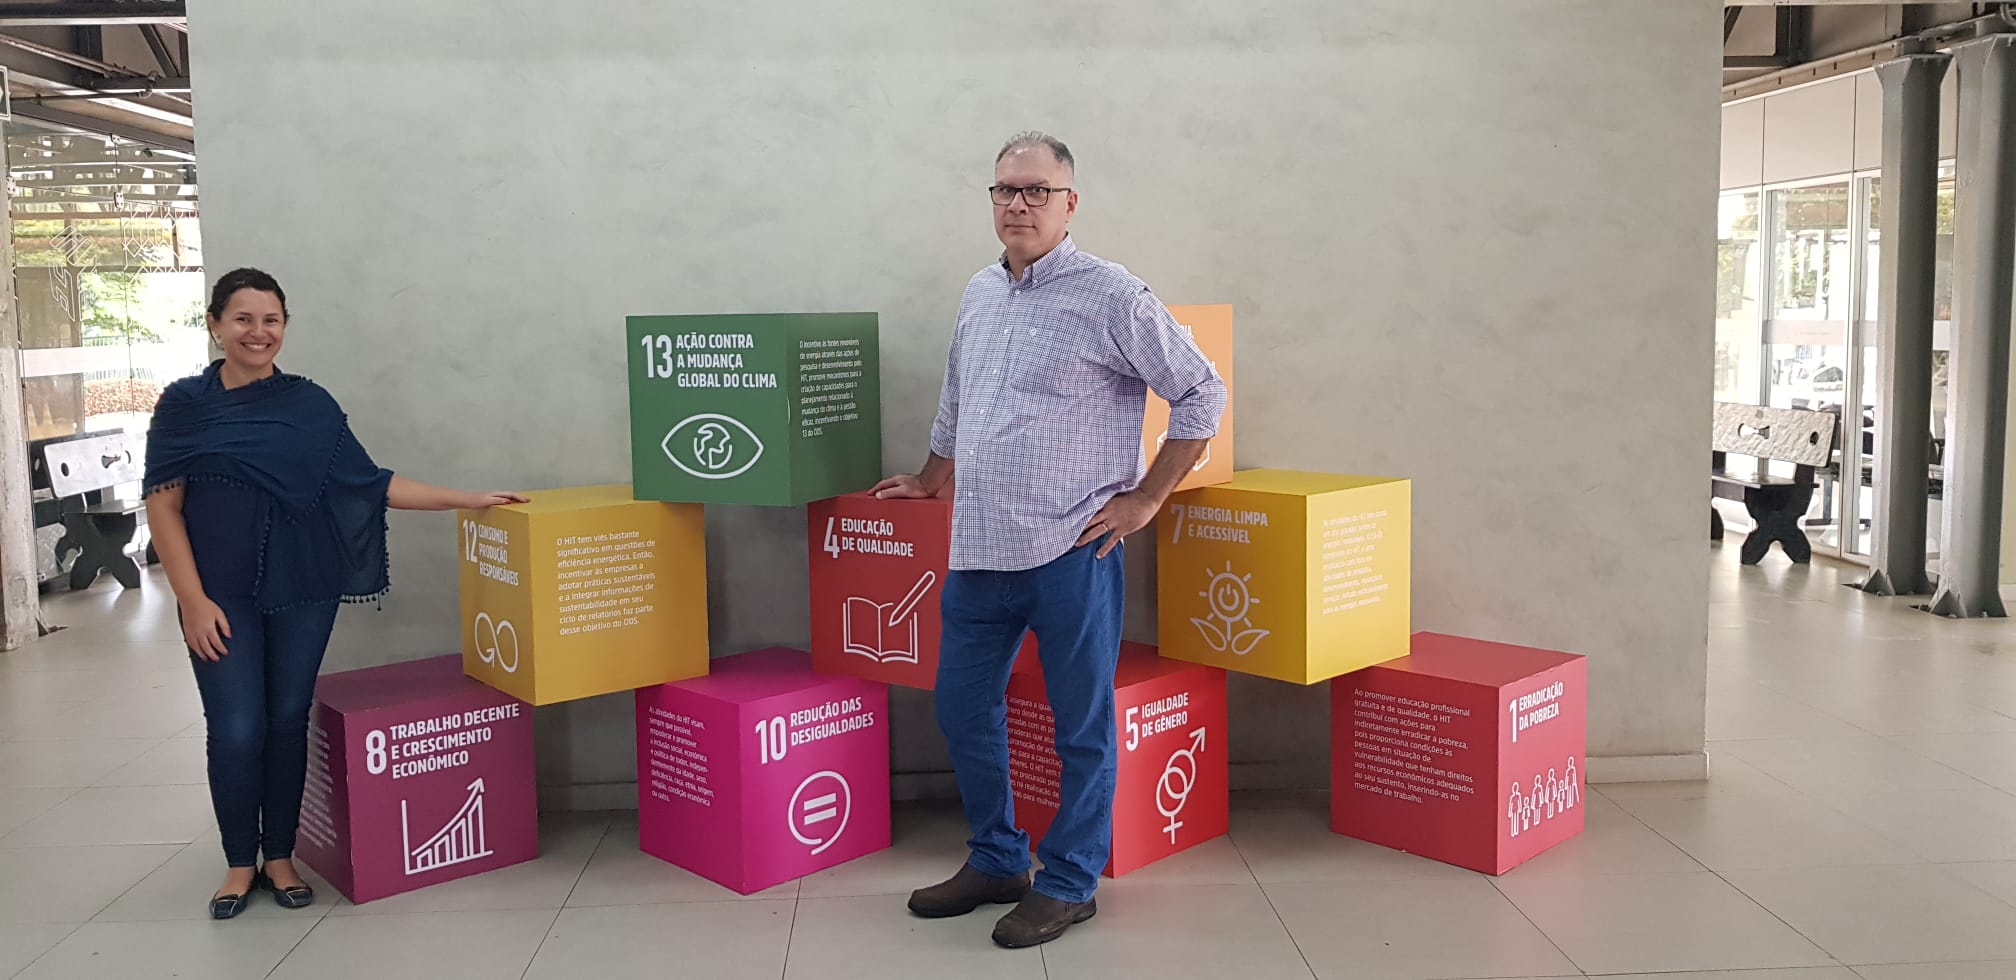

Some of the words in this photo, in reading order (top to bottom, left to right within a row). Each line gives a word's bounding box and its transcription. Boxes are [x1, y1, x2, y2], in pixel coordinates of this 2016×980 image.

[676, 332, 706, 351] AÇÃO
[709, 334, 754, 348] CONTRA
[642, 335, 673, 378] 13
[677, 354, 685, 368] A
[688, 354, 743, 371] MUDANÇA
[678, 374, 720, 387] GLOBAL
[724, 374, 739, 387] DO
[742, 374, 777, 388] CLIMA
[842, 518, 893, 537] EDUCAÇÃO
[1170, 504, 1185, 544] 7
[1188, 506, 1232, 523] ENERGIA
[1235, 510, 1268, 526] LIMPA
[463, 520, 478, 563] 12
[479, 524, 504, 543] CONSUMO
[505, 531, 508, 544] E
[824, 517, 839, 558] 4
[842, 537, 854, 550] DE
[857, 538, 913, 557] QUALIDADE
[1188, 524, 1194, 536] E
[1196, 524, 1250, 543] ACESSÍVEL
[479, 542, 508, 564] PRODUÇÃO
[480, 561, 518, 586] RESPONSÁVEIS
[1142, 692, 1188, 719] IGUALDADE
[1355, 688, 1363, 696] Ao
[1365, 691, 1396, 702] promover
[1398, 696, 1429, 709] educação
[1431, 703, 1470, 716] profissional
[1520, 680, 1563, 711] ERRADICAÇÃO
[390, 714, 461, 740] TRABALHO
[464, 703, 519, 726] DECENTE
[791, 702, 839, 727] REDUÇÃO
[842, 697, 861, 714] DAS
[1142, 721, 1153, 738] DE
[1155, 711, 1187, 733] GÊNERO
[1355, 710, 1382, 720] contribui
[1384, 715, 1398, 723] com
[1400, 718, 1418, 728] ações
[1420, 723, 1435, 731] para
[1510, 699, 1517, 742] 1
[1520, 714, 1528, 730] DA
[1530, 702, 1559, 726] POBREZA
[756, 716, 787, 764] 10
[792, 712, 874, 746] DESIGUALDADES
[1126, 706, 1138, 751] 5
[1355, 720, 1400, 734] indiretamente
[1402, 729, 1430, 741] erradicar
[366, 730, 387, 775] 8
[392, 746, 399, 760] E
[403, 727, 491, 757] CRESCIMENTO
[1355, 742, 1380, 752] pessoas
[1394, 749, 1420, 760] situação
[393, 751, 469, 779] ECONÔMICO
[1355, 752, 1404, 767] vulnerabilidade
[1406, 762, 1418, 771] que
[1420, 765, 1445, 777] tenham
[1447, 770, 1473, 783] direitos
[1368, 764, 1394, 776] recursos
[1436, 780, 1474, 794] adequados
[1355, 782, 1382, 794] mercado
[1408, 783, 1449, 799] inserindo-as
